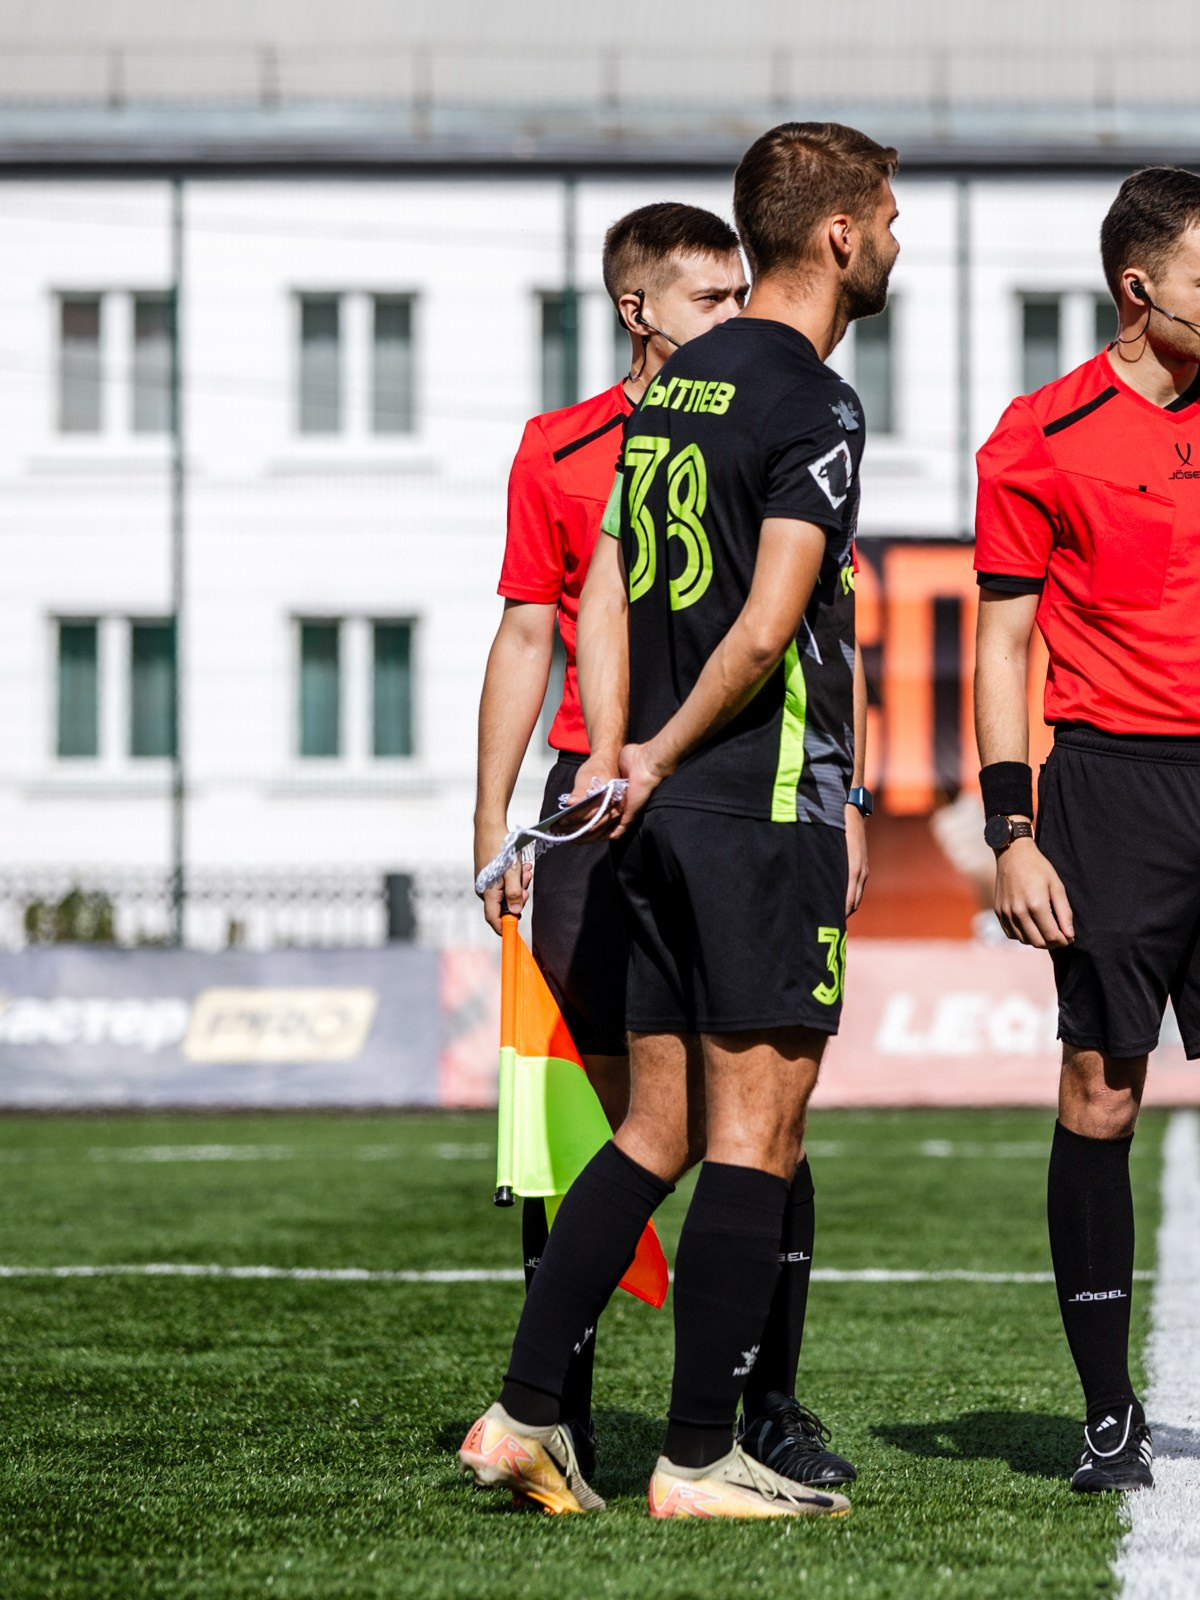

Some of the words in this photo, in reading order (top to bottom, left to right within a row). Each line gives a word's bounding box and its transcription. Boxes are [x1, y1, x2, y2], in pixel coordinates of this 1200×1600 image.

[624, 435, 713, 612] 38
[811, 926, 848, 1006] 3
[876, 993, 1058, 1056] LEO
[1068, 1289, 1128, 1301] JÖGEL
